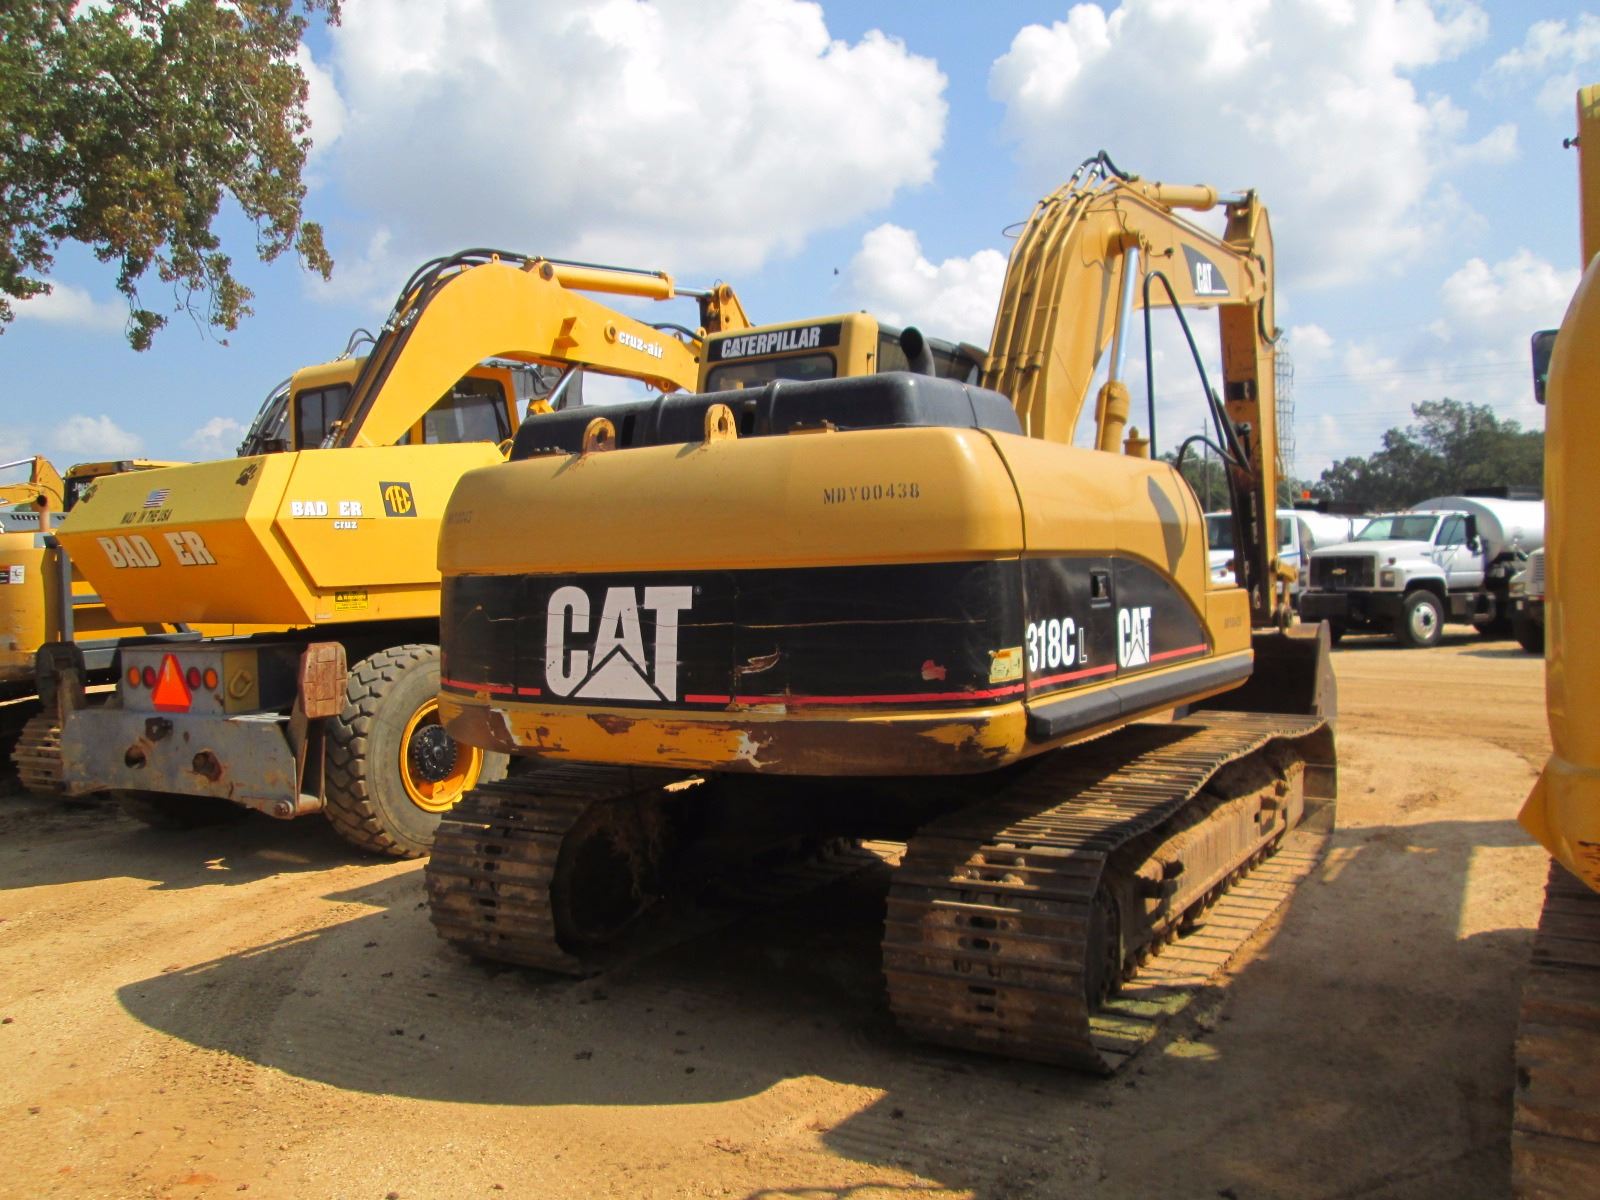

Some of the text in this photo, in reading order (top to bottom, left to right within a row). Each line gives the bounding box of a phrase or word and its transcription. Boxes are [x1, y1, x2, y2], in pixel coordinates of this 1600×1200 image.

[1196, 262, 1212, 294] CAT
[618, 332, 664, 359] cruz-air
[721, 326, 821, 358] CATERPILLAR
[823, 483, 920, 505] MDY00438
[334, 520, 358, 530] cruz
[545, 585, 693, 702] CAT
[1118, 606, 1152, 668] CAT
